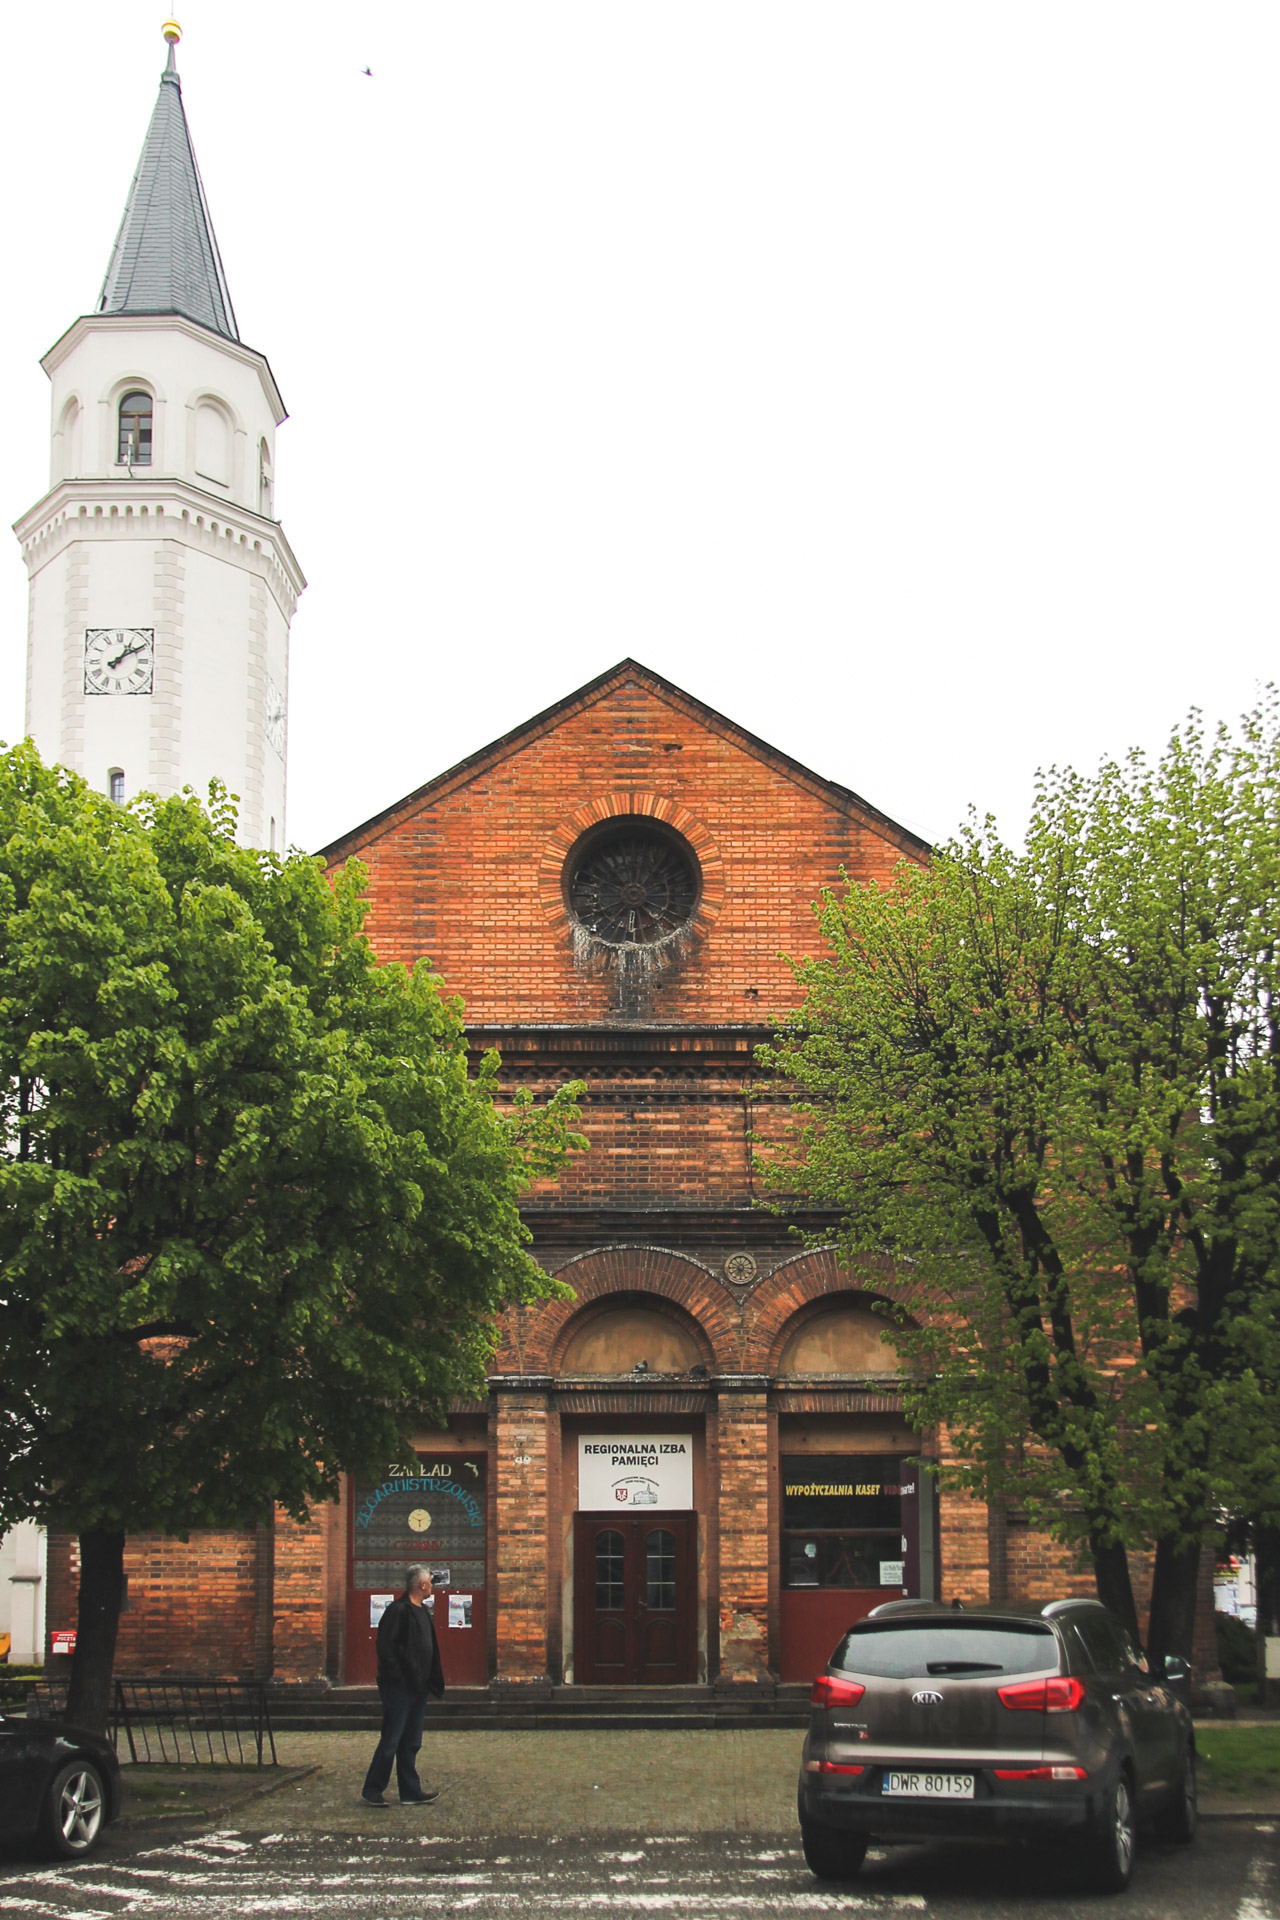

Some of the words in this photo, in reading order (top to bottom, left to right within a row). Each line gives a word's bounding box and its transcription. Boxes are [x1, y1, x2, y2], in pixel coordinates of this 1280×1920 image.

[584, 1444, 657, 1455] REGIONALNA
[659, 1444, 686, 1454] IZBA
[611, 1456, 659, 1468] PAMIĘCI
[388, 1463, 452, 1477] ZAŁAD
[785, 1482, 853, 1496] WYPOŻYCZALNIA
[855, 1484, 880, 1495] KASET
[916, 1694, 938, 1704] KIA
[890, 1774, 920, 1791] DWR
[924, 1775, 973, 1793] 80159
